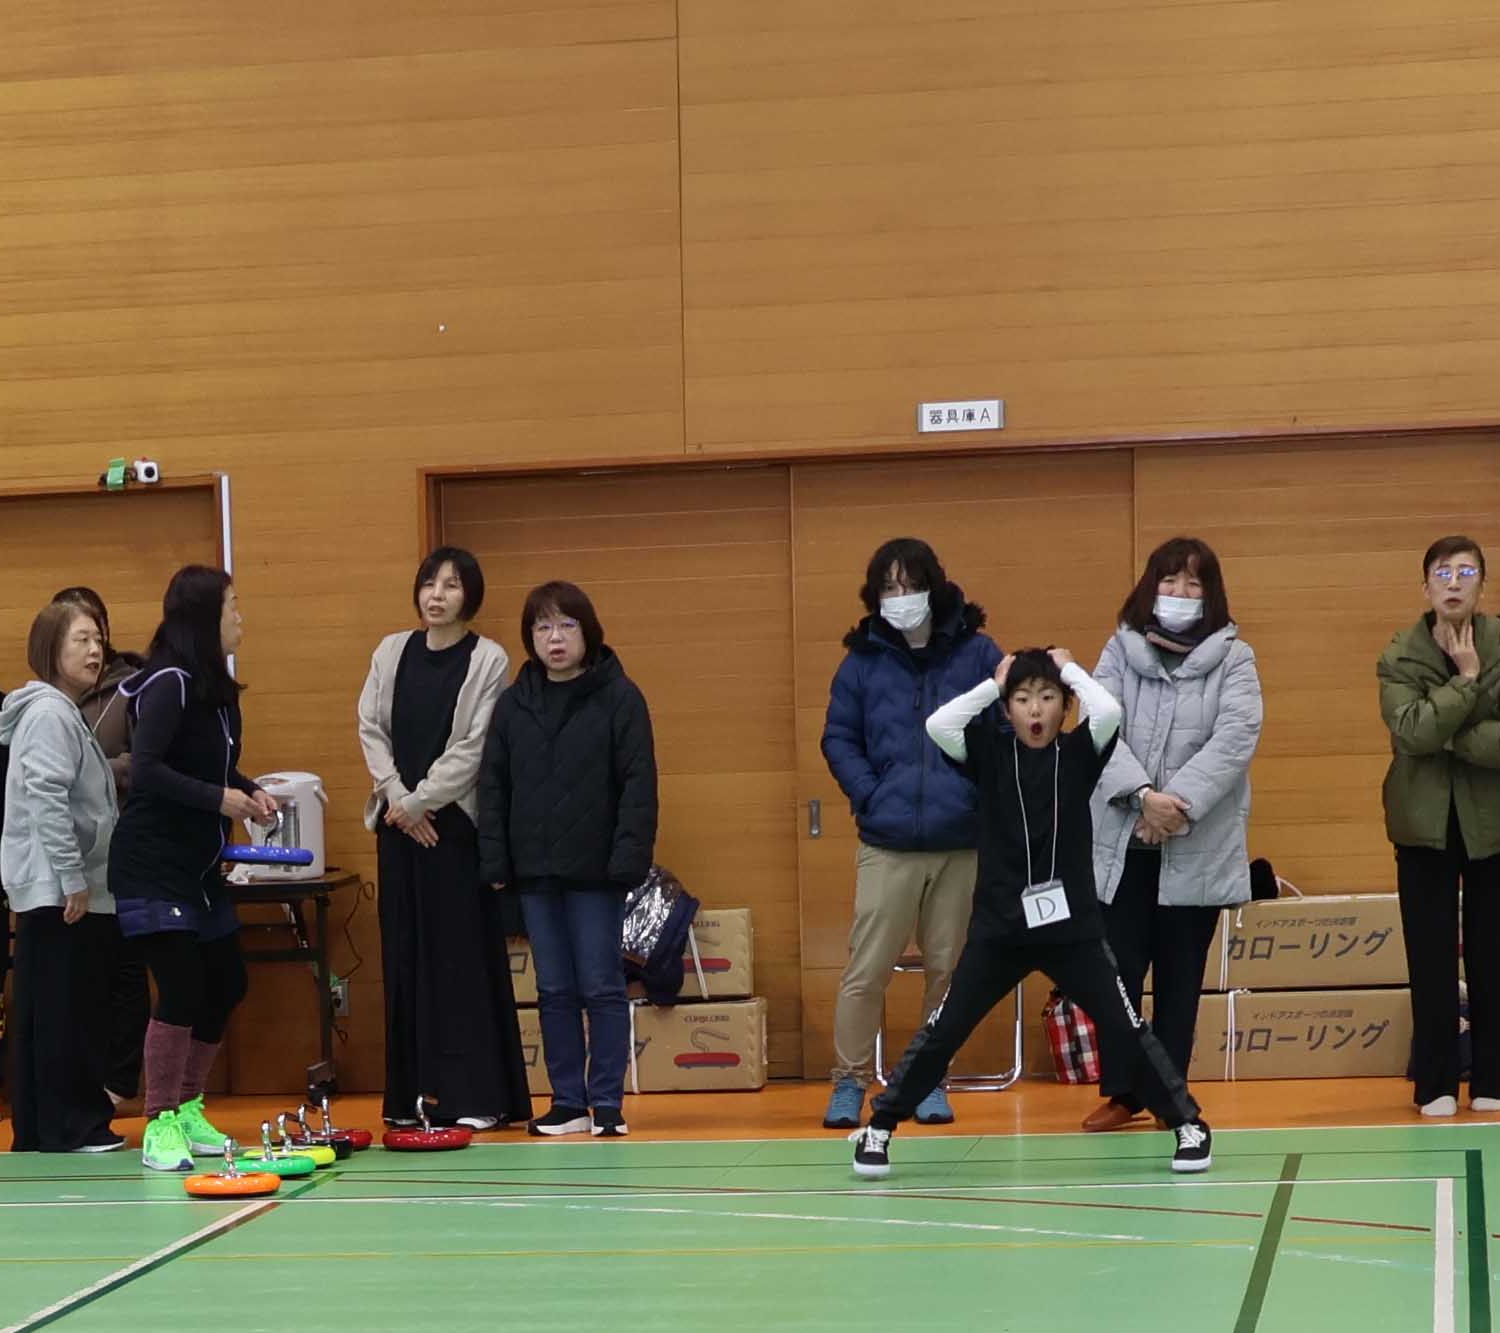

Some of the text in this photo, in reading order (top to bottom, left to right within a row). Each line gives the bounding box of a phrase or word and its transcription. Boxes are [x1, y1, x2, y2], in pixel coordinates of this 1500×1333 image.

[929, 408, 991, 424] 器具庫A
[1035, 896, 1056, 921] D
[1227, 928, 1393, 960] カローリング
